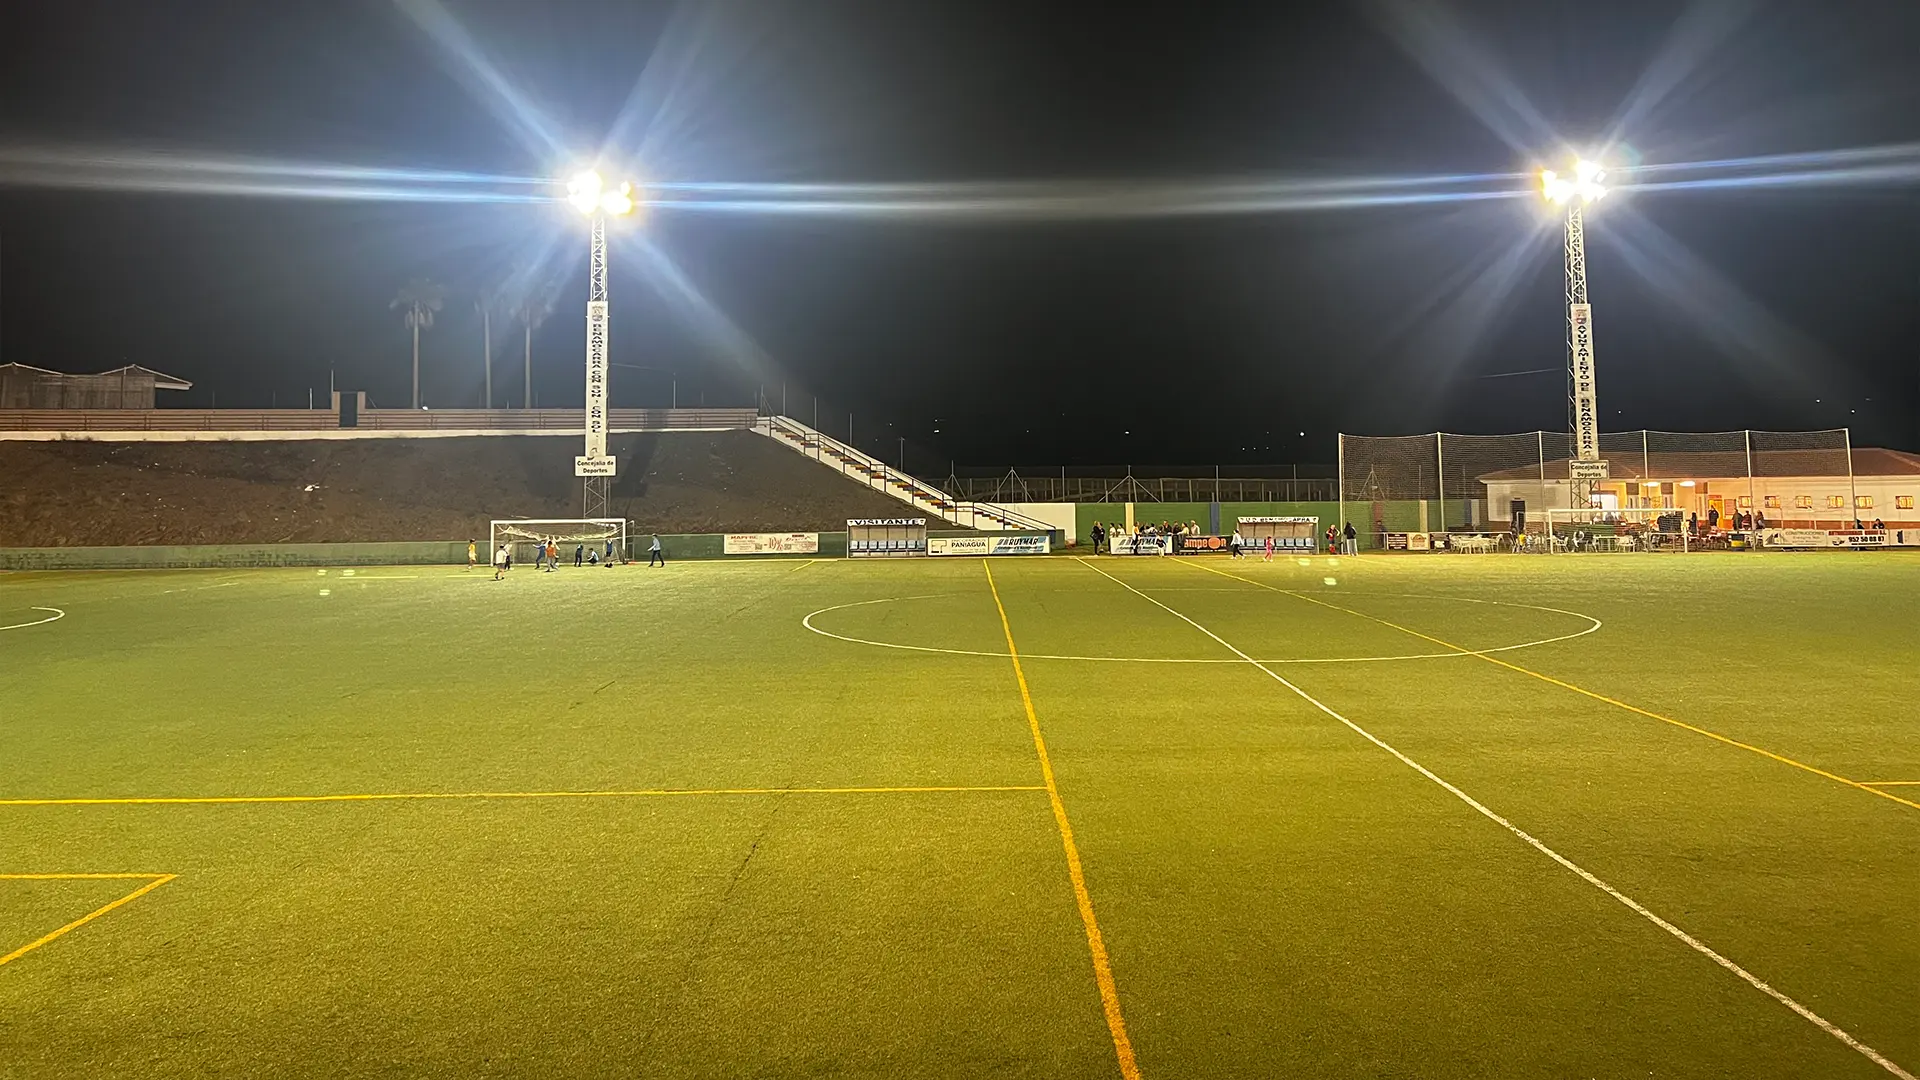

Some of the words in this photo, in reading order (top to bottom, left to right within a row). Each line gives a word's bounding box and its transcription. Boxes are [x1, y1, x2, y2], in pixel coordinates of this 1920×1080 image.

[1578, 325, 1590, 380] AYUNTAMIENTO
[1580, 382, 1590, 392] DE
[1580, 399, 1593, 449] BENAMOCARRA
[1008, 538, 1038, 546] RUYMAR
